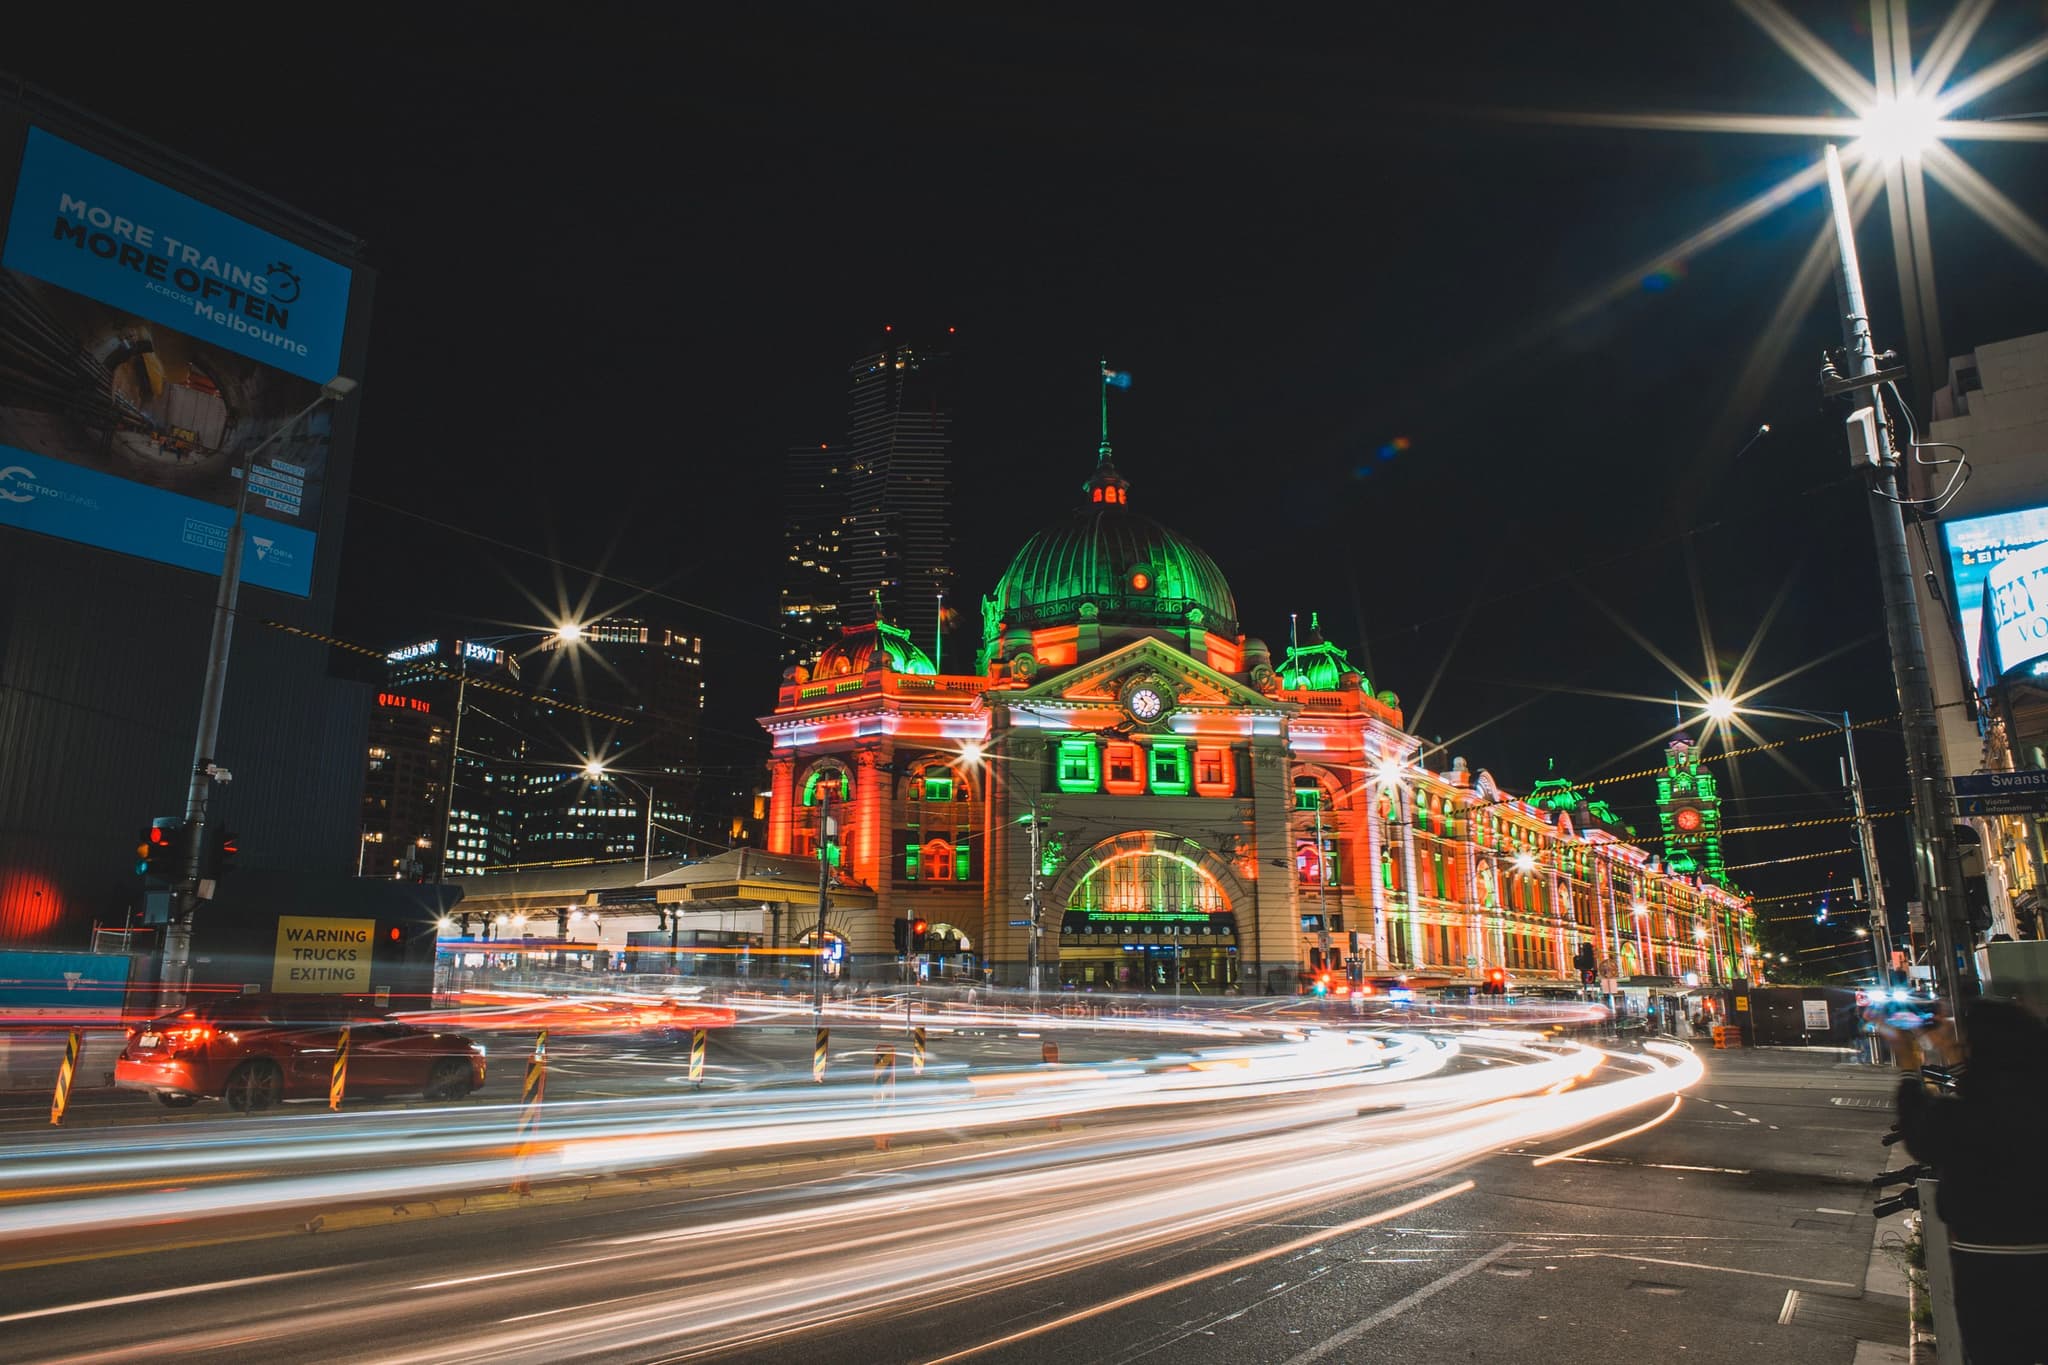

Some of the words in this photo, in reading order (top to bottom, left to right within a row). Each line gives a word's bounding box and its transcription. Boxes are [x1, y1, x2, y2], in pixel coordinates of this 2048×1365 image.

[58, 192, 155, 249] MORE
[163, 236, 269, 296] TRAINS
[53, 216, 169, 282] MORE
[174, 267, 290, 332] OFTEN
[144, 281, 194, 307] ACROSS
[194, 300, 309, 358] Melbourne
[379, 693, 406, 707] QUAY
[411, 698, 430, 713] WEST
[1991, 774, 2048, 787] Swanst
[286, 928, 367, 942] WARNING
[292, 948, 357, 961] TRUCKS
[290, 967, 356, 981] EXITING
